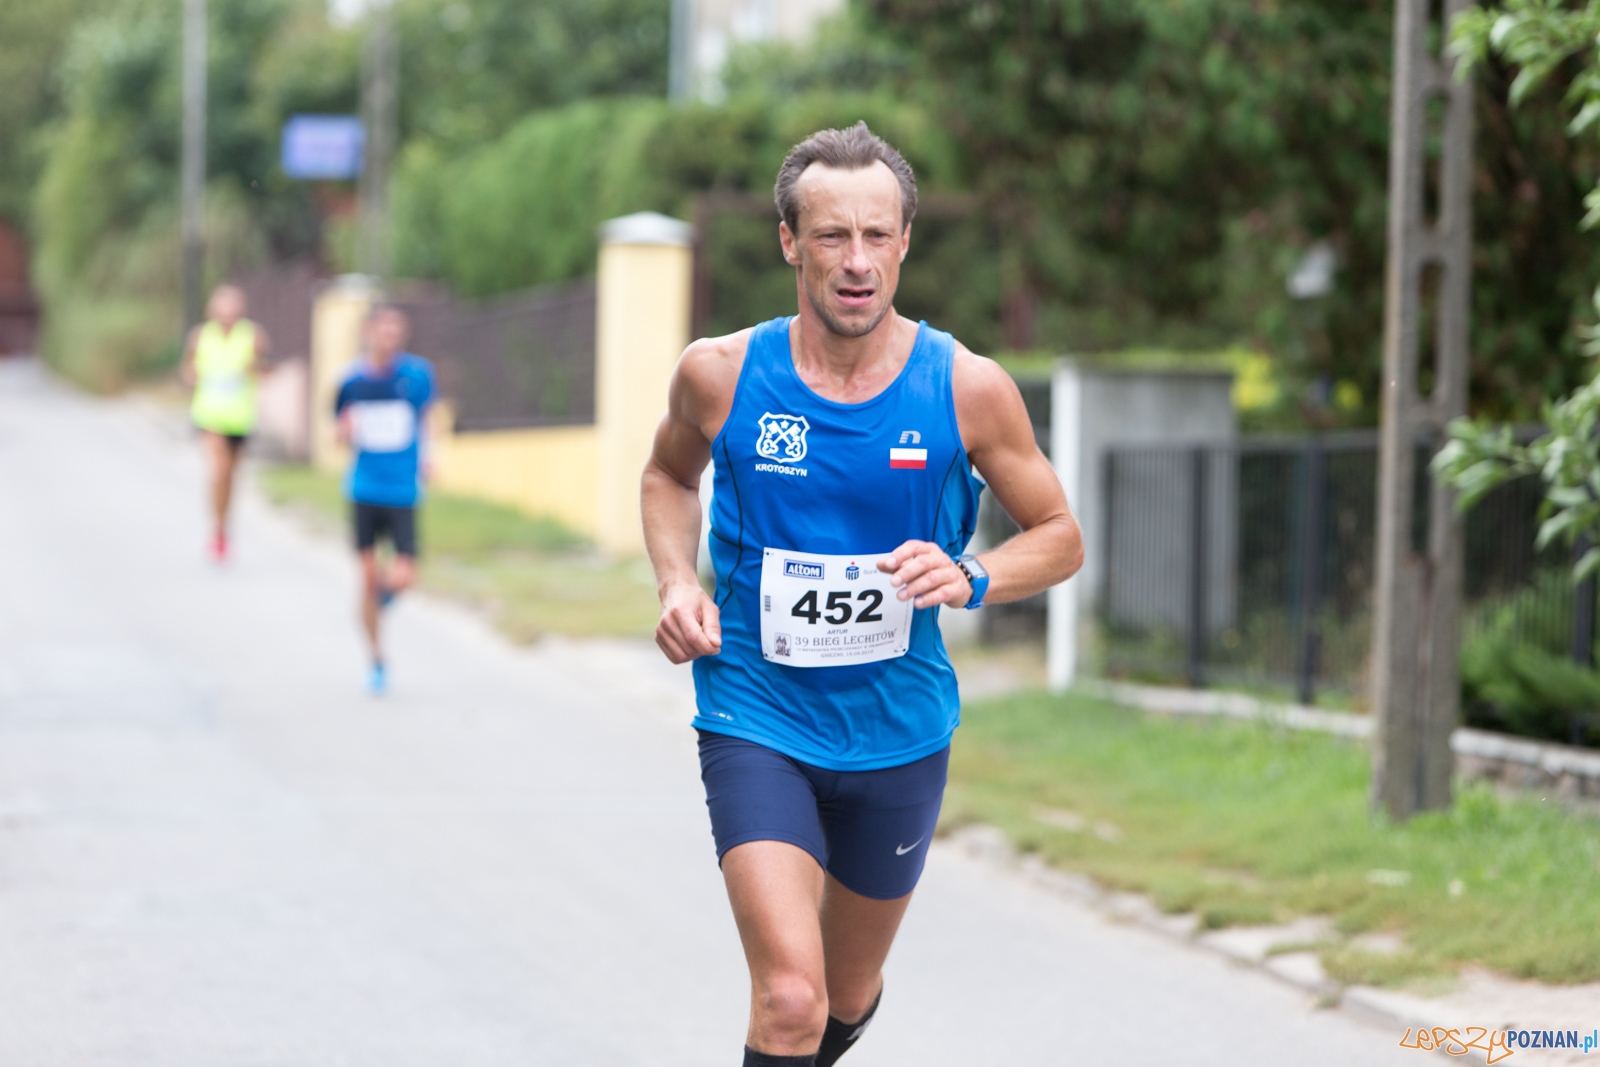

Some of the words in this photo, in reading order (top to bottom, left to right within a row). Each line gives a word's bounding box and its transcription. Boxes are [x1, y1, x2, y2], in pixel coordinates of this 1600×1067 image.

[755, 463, 807, 477] KROTOSZYN
[791, 589, 883, 625] 452
[794, 636, 809, 647] 39
[812, 636, 840, 646] BIEG
[843, 628, 897, 645] LECHITÓW
